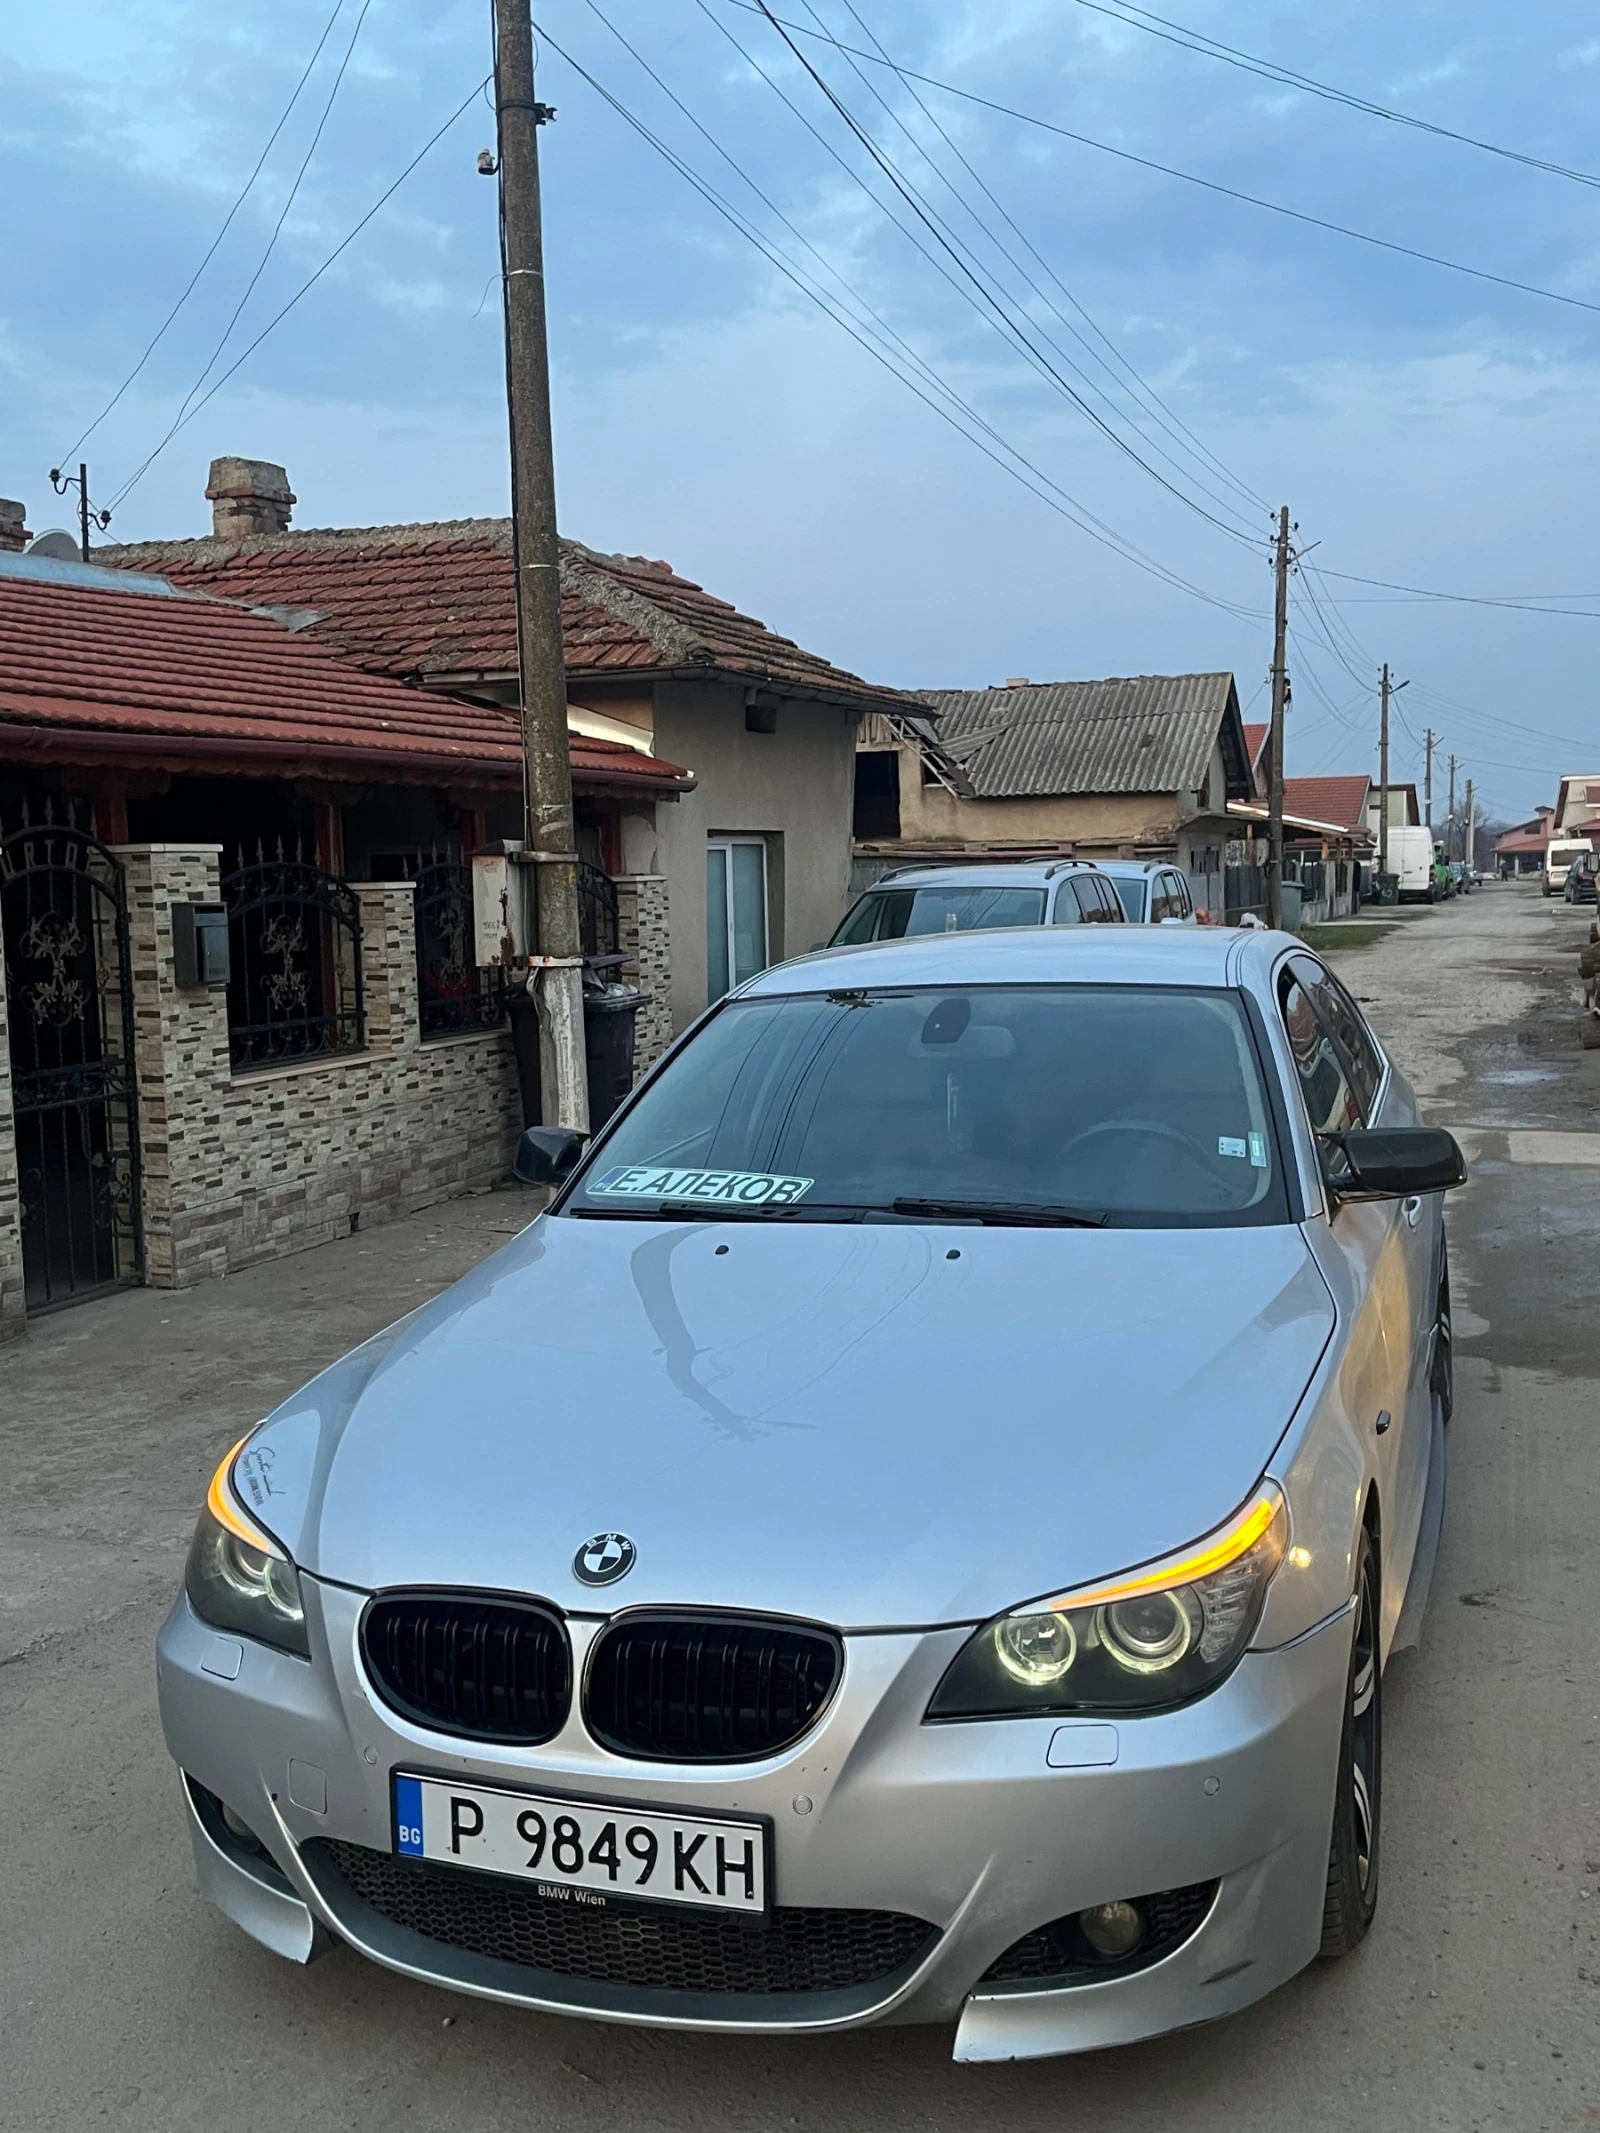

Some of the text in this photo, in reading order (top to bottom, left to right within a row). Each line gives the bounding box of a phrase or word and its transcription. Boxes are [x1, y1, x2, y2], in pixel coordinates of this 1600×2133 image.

[610, 1169, 803, 1204] Е.АЛЕКОВ
[586, 1533, 632, 1551] BMW
[399, 1824, 421, 1845] BG
[449, 1795, 755, 1900] P 9849 KH
[537, 1884, 606, 1906] BMW Wien
